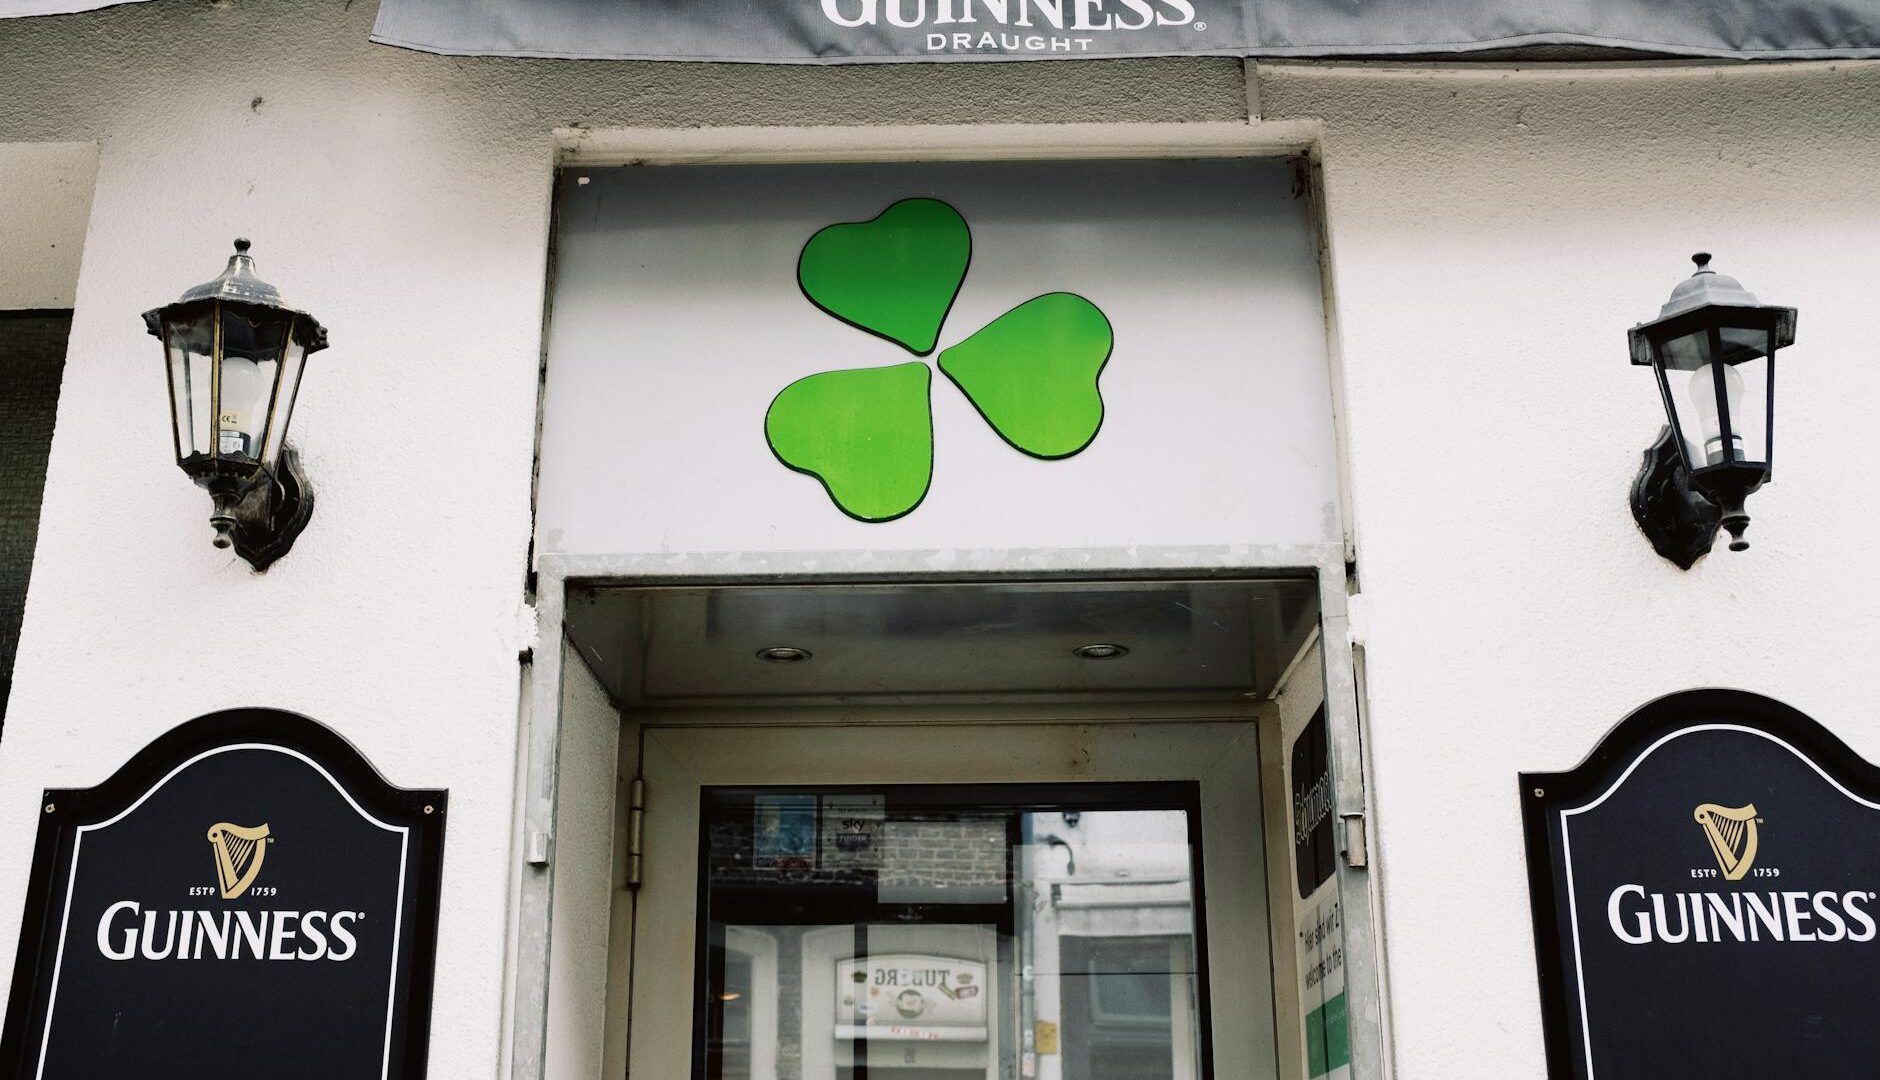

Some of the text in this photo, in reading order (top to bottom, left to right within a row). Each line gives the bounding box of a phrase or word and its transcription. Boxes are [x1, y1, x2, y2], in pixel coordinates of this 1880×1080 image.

[926, 31, 1093, 51] DRAUGHT
[842, 818, 865, 831] sky
[1753, 868, 1780, 877] 1759
[251, 887, 277, 896] 1759
[1607, 884, 1877, 944] GUINNESS
[97, 900, 357, 961] GUINNESS
